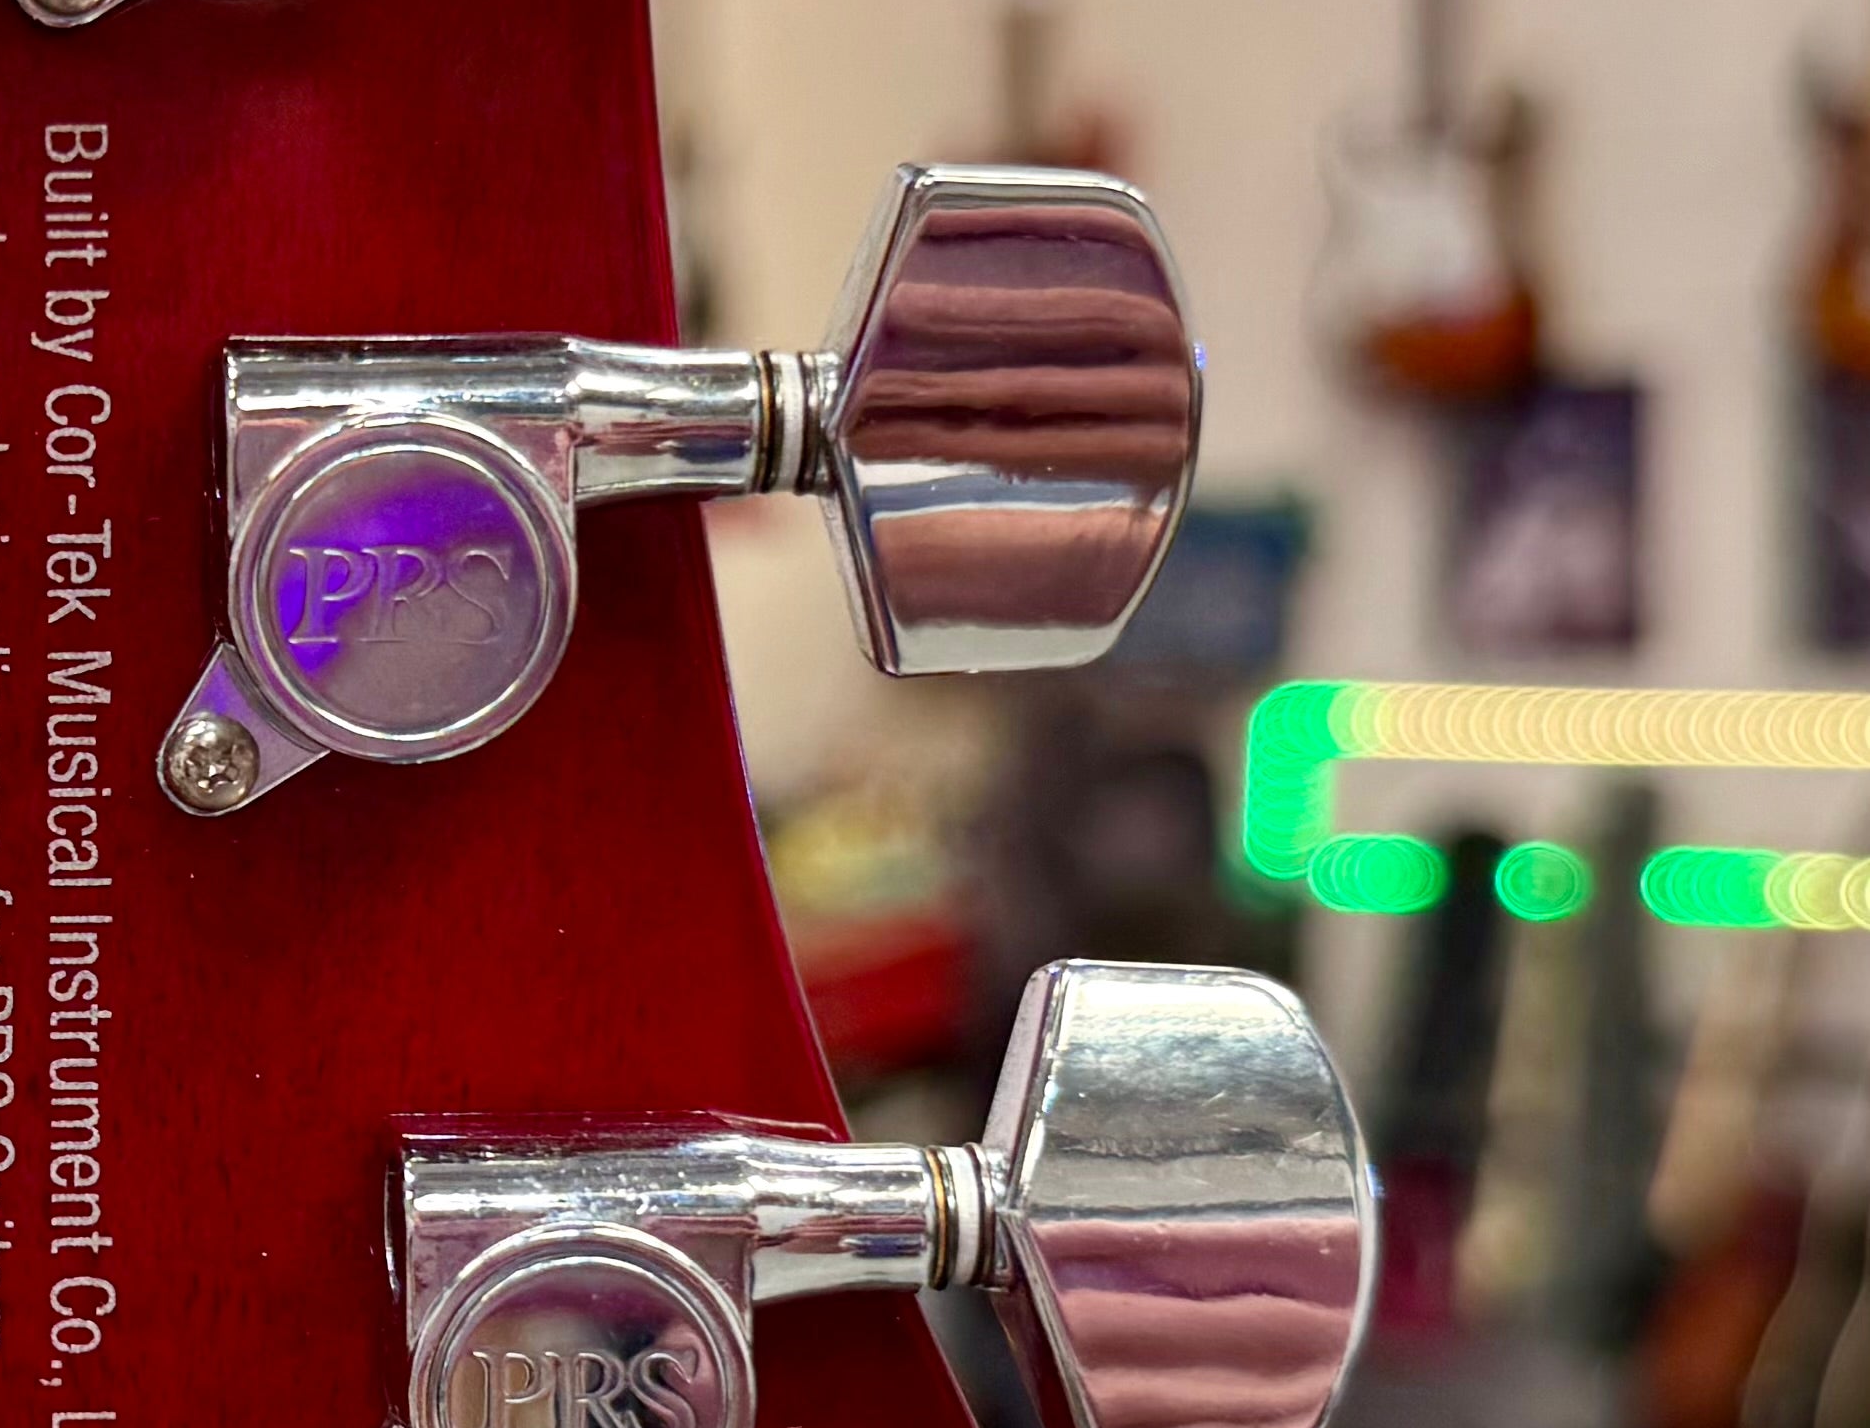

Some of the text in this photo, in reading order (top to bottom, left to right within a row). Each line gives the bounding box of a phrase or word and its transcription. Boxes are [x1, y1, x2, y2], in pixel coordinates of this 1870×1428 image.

[44, 123, 109, 268] Built
[30, 289, 110, 362] by
[44, 384, 112, 624] Cor-Tek
[286, 545, 514, 647] PRS
[46, 650, 113, 887] Musical
[48, 915, 113, 1254] Instrument
[39, 1276, 117, 1387] Co.,
